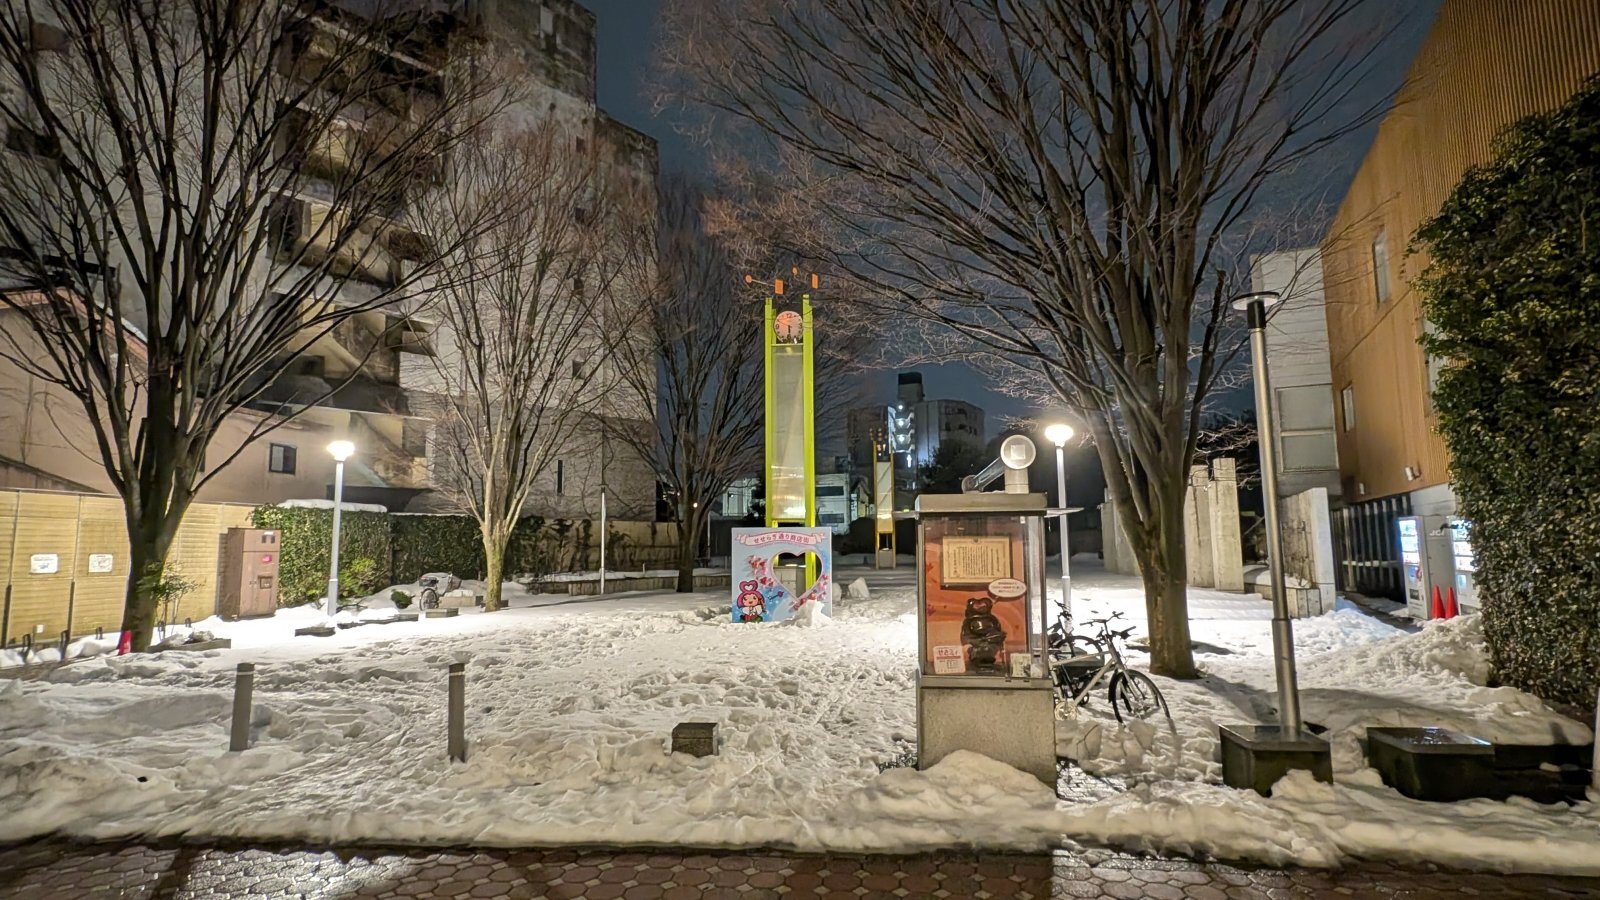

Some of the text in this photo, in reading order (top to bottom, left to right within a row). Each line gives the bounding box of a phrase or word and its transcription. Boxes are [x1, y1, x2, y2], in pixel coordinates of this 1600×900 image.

[754, 533, 810, 543] せせらぎ通り商店街
